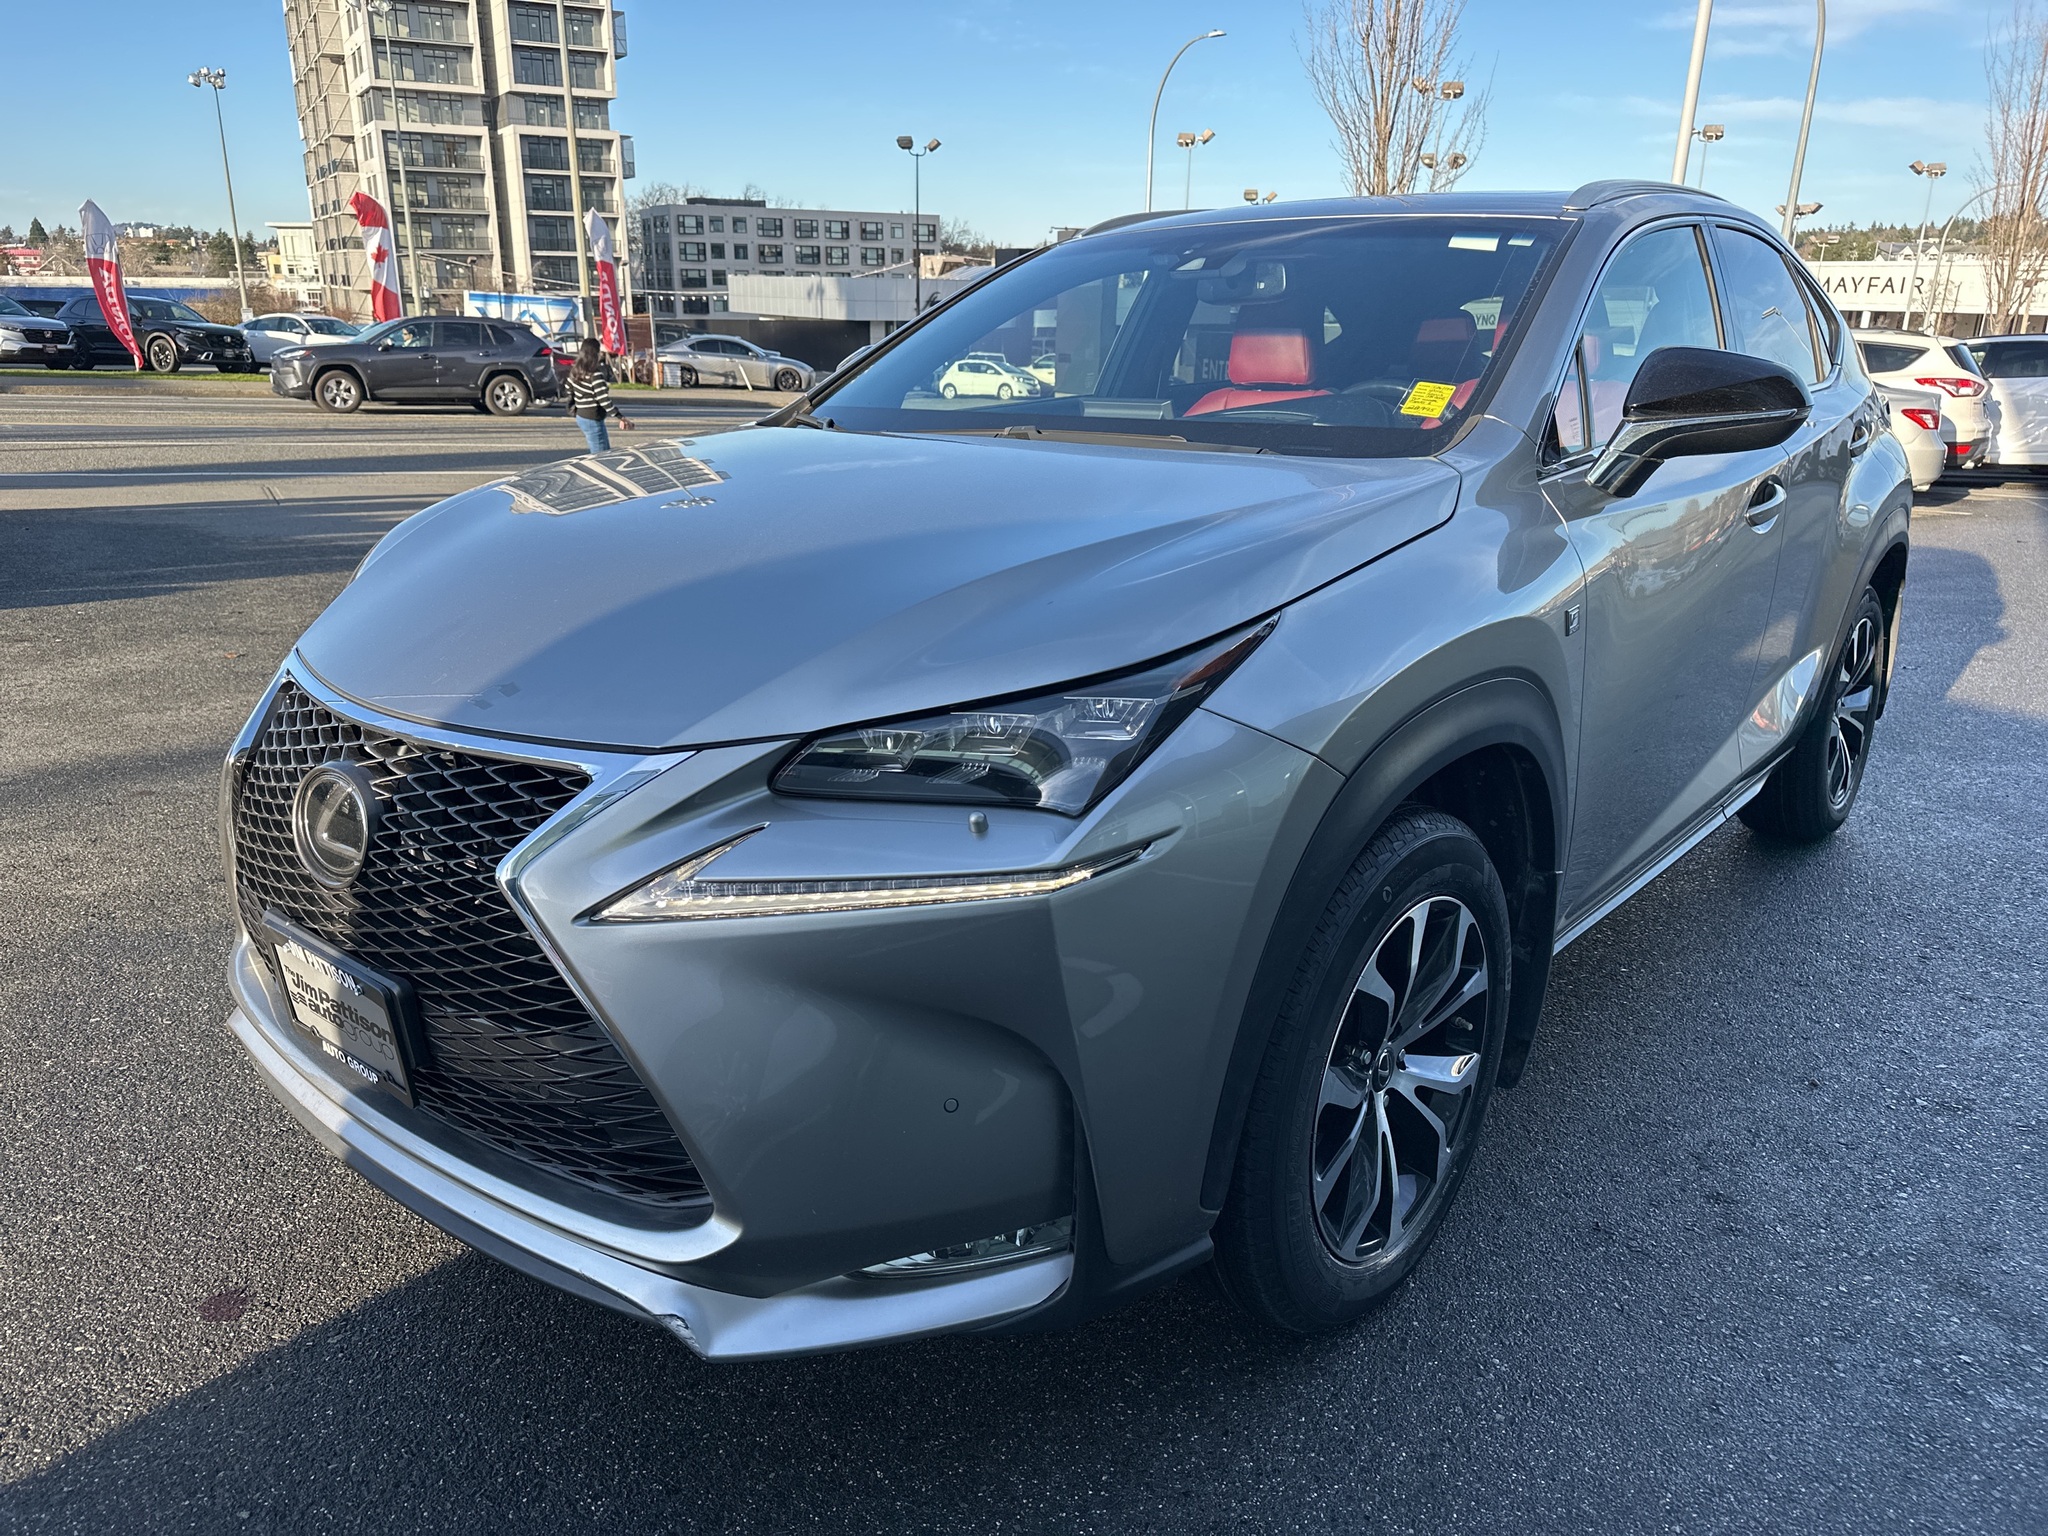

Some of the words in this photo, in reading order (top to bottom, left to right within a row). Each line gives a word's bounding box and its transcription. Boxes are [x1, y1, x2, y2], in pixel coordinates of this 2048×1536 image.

[304, 949, 356, 991] PATTISON
[322, 1040, 346, 1064] AUTO
[347, 1055, 379, 1084] GROUP
